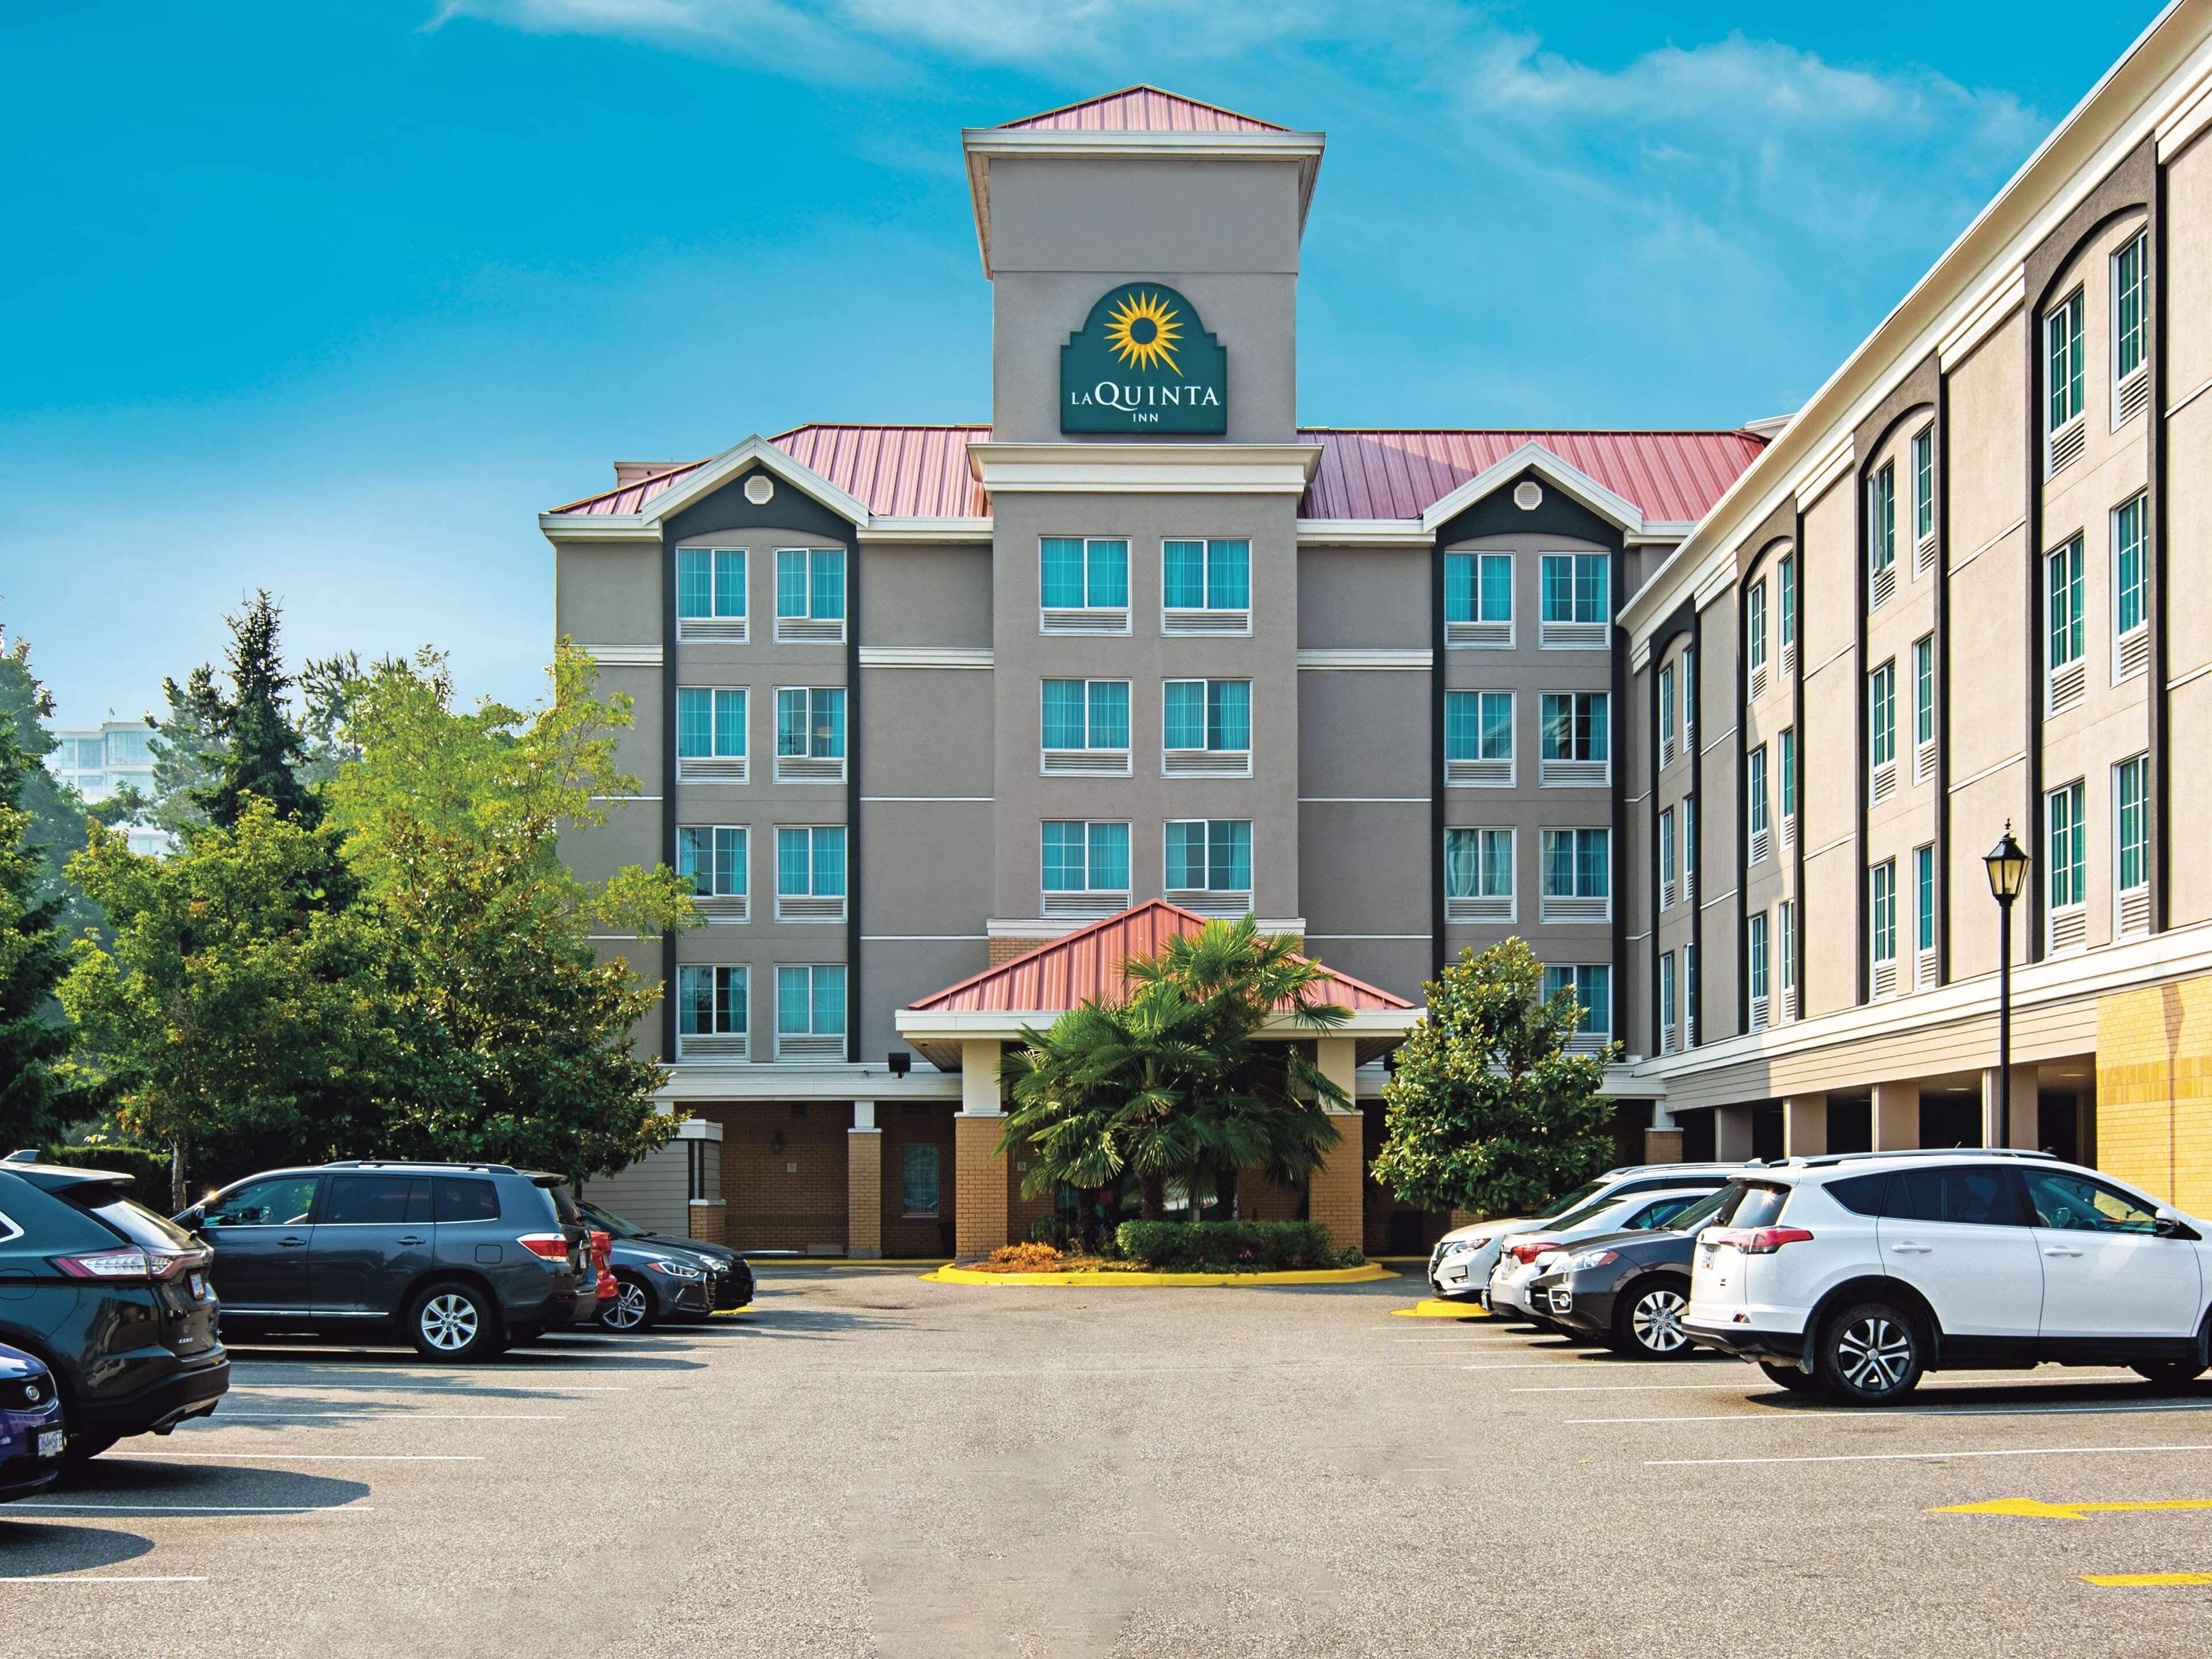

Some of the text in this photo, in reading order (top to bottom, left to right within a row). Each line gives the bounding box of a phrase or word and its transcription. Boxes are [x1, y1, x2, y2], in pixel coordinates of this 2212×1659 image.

[1071, 381, 1219, 412] LA QUINTA
[1133, 413, 1158, 422] INN
